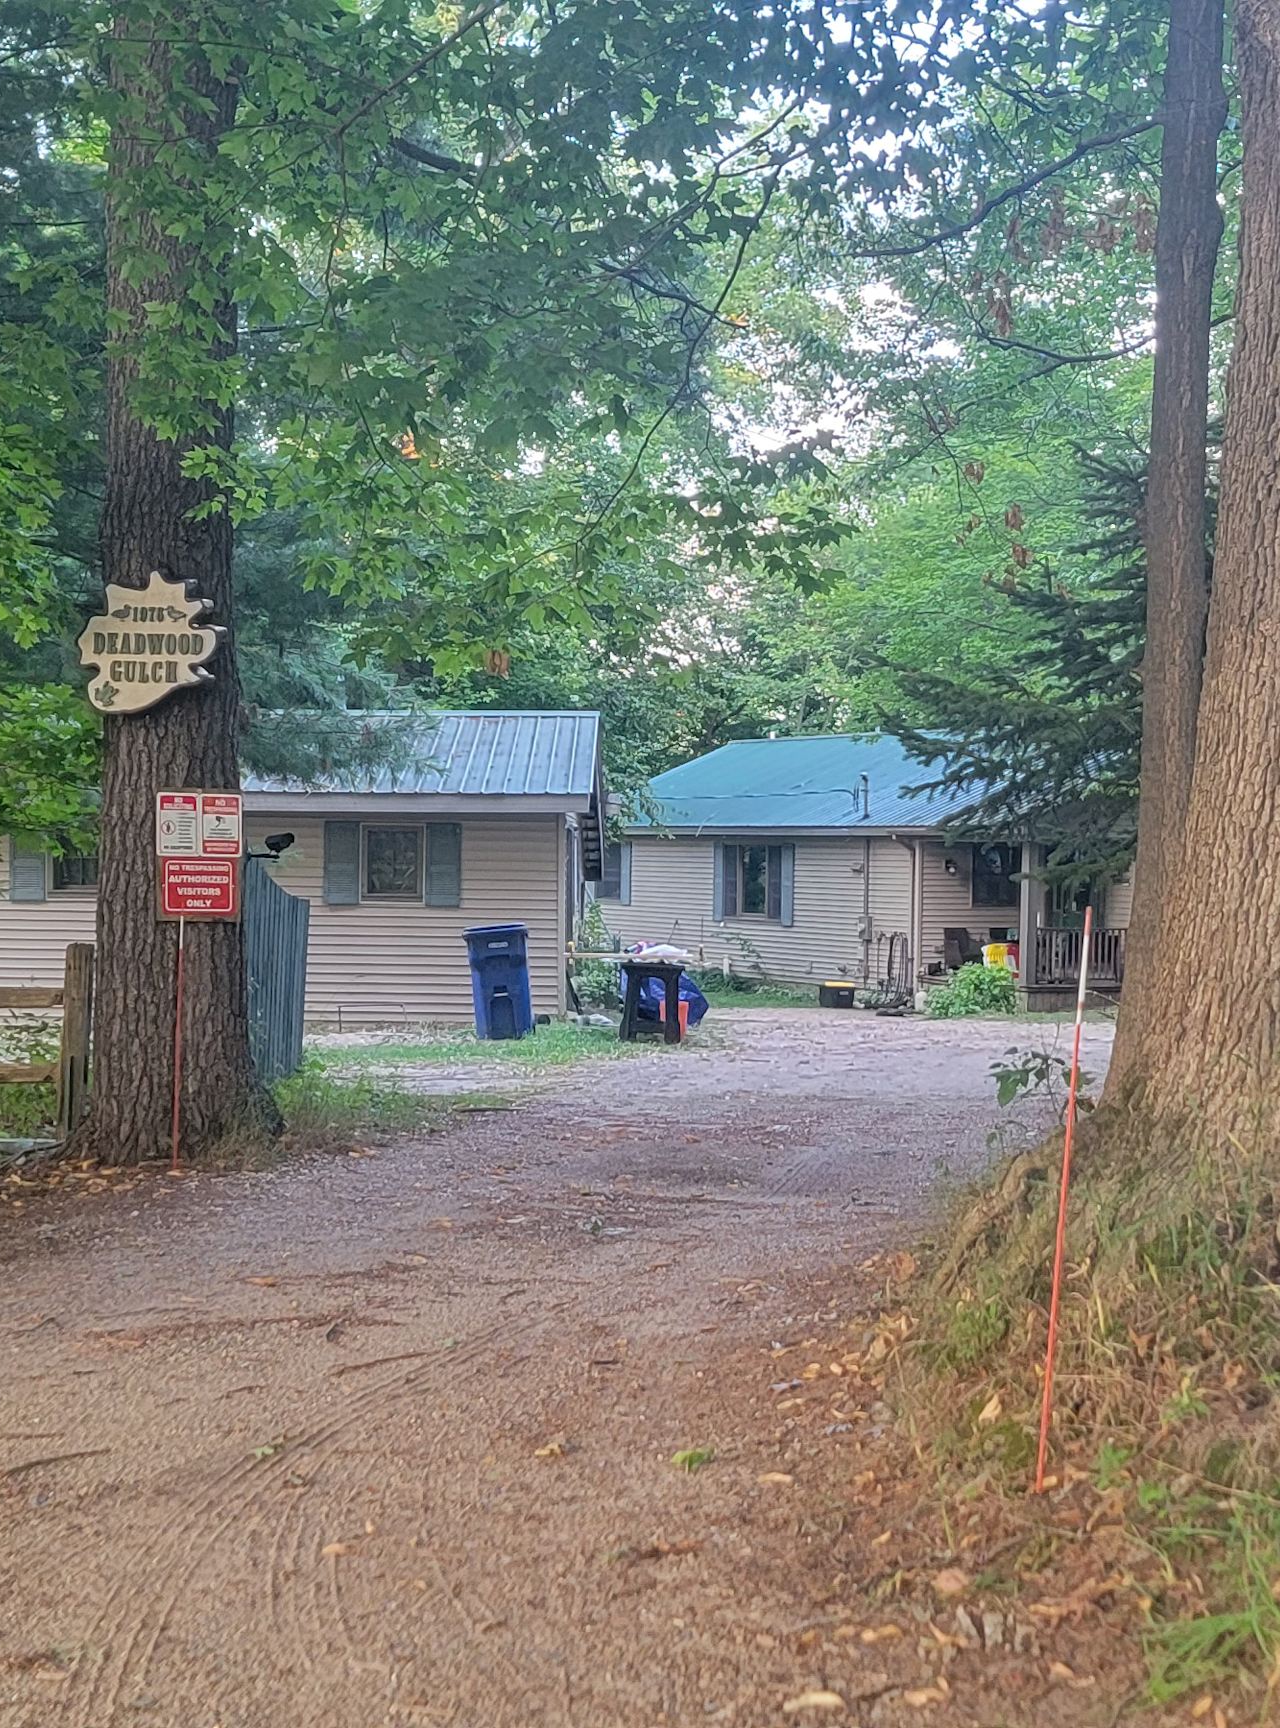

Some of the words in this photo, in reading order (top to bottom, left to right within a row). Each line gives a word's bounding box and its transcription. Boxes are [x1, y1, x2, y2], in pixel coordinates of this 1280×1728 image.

[93, 632, 204, 655] DEADWOOD
[111, 660, 178, 683] GULCH
[169, 875, 229, 883] AUTHORIZED
[177, 887, 221, 895] VISITORS
[186, 899, 212, 907] ONLY
